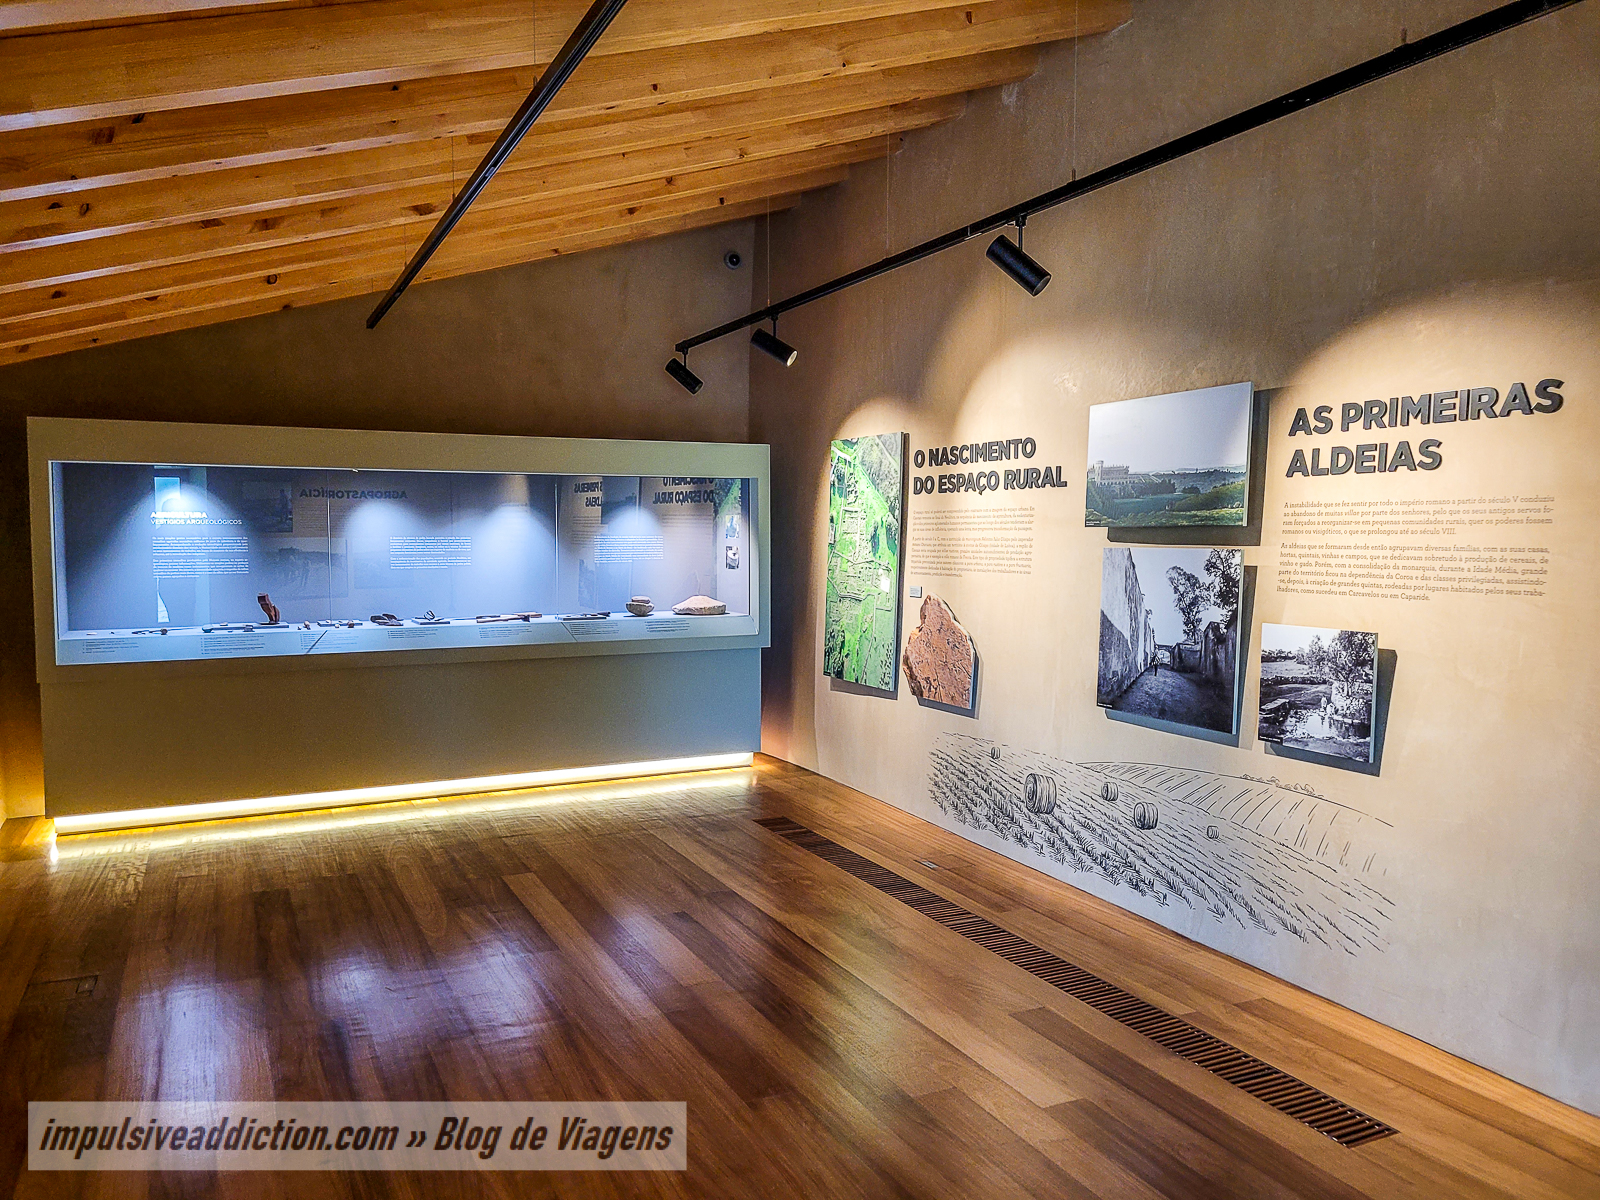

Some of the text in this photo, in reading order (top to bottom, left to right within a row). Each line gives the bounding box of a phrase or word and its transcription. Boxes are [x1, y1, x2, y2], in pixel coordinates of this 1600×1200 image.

[1288, 378, 1565, 436] AS PRIMEIRAS
[914, 437, 1036, 468] O NASCIMENTO
[1286, 438, 1443, 478] ALDEIAS
[913, 466, 1068, 495] DO ESPAÇO RURAL
[1400, 498, 1424, 508] império
[1458, 497, 1476, 506] partir
[1488, 496, 1511, 504] século
[1373, 508, 1388, 517] parte
[1402, 508, 1430, 516] senhores,
[1433, 507, 1446, 516] pelo
[1489, 506, 1514, 516] antigos
[1294, 519, 1315, 527] forçados
[1322, 518, 1360, 527] reorganizar-se
[1446, 517, 1466, 526] rurais,
[1495, 517, 1523, 526] poderes
[1313, 528, 1342, 536] visigóticos,
[1368, 527, 1398, 536] prolongou
[1453, 544, 1481, 553] famílias,
[1298, 552, 1320, 561] quintais,
[1390, 553, 1422, 561] dedicavam
[1425, 554, 1457, 562] sobretudo
[1465, 555, 1497, 564] produção
[1315, 561, 1333, 569] Porém,
[1353, 562, 1390, 572] consolidação
[1439, 564, 1464, 572] durante
[1473, 565, 1492, 573] Idade
[1495, 565, 1518, 575] Média,
[1521, 566, 1548, 576] grande
[1278, 568, 1291, 577] parte
[1348, 571, 1384, 581] dependência
[1433, 574, 1456, 582] classes
[1458, 575, 1504, 586] privilegiadas,
[1506, 576, 1546, 585] assistindo-
[1287, 578, 1304, 587] depois,
[1310, 578, 1328, 588] criação
[1338, 580, 1359, 589] grandes
[1361, 581, 1383, 590] quintas,
[1385, 582, 1411, 590] rodeadas
[1413, 584, 1424, 592] por
[1426, 583, 1449, 593] lugares
[1451, 584, 1483, 593] habitados
[1485, 586, 1503, 596] pelos
[1523, 588, 1546, 596] traba-
[1316, 587, 1337, 596] sucedeu
[1349, 589, 1379, 598] Carcavelos
[1401, 592, 1430, 603] Caparide.
